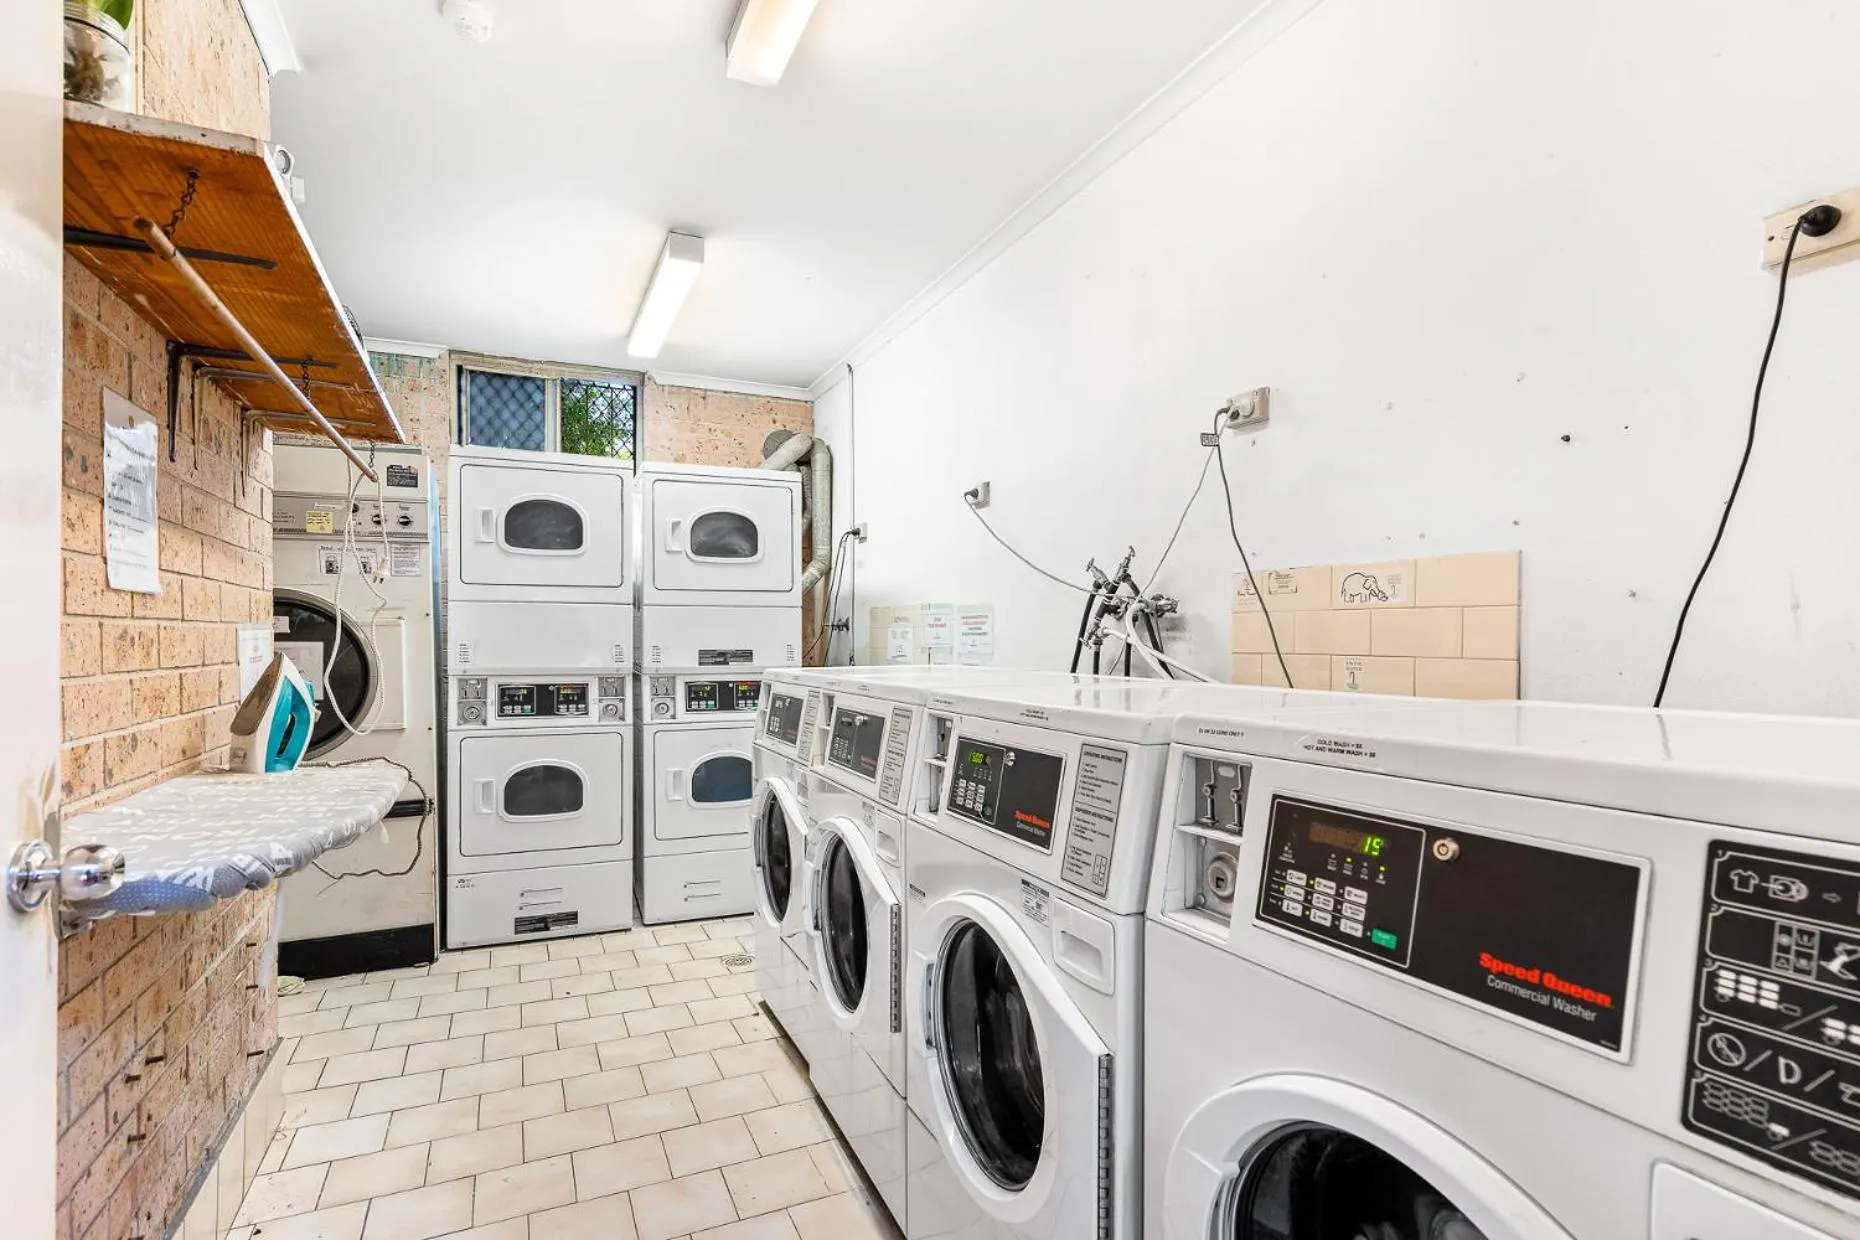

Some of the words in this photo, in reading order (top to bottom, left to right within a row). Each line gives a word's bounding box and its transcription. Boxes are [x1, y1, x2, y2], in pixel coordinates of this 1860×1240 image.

[1346, 749, 1363, 757] WASH
[1479, 951, 1541, 985] Speed
[1542, 971, 1612, 1008] Queen
[1487, 974, 1550, 1006] Commercial
[1552, 996, 1598, 1022] Washer
